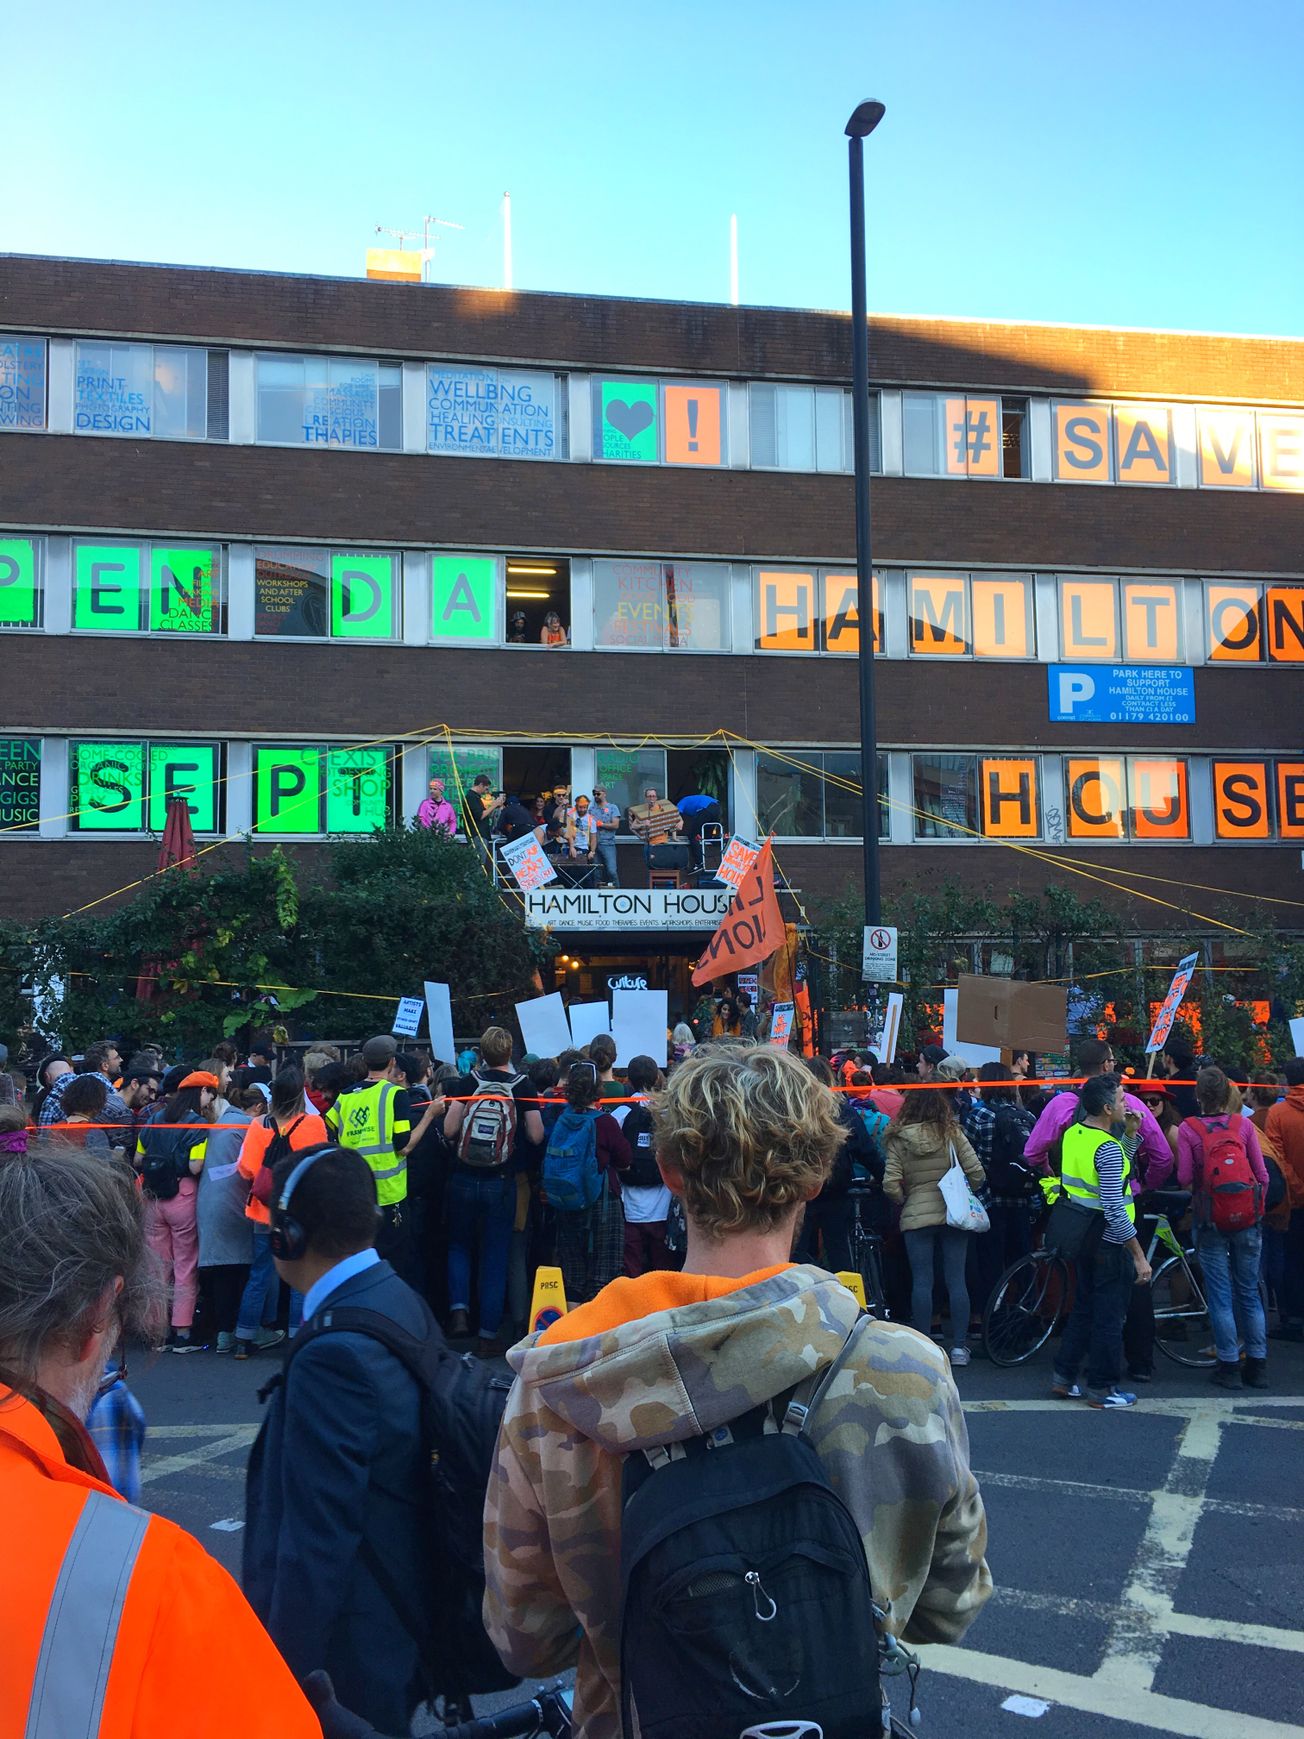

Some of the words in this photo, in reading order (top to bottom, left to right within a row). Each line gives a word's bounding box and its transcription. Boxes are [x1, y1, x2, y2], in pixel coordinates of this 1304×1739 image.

[77, 376, 126, 390] PRINT
[76, 413, 151, 431] DESIGN
[431, 411, 496, 427] HEALING
[257, 580, 308, 588] WORKSHOPS
[280, 588, 303, 596] AFTER
[261, 596, 295, 604] SCHOOL
[766, 584, 1304, 650] HAMILTON
[1112, 669, 1138, 678] PARK
[1141, 671, 1167, 679] HERE
[1169, 671, 1183, 679] TO
[1126, 679, 1171, 687] SUPPORT
[1059, 673, 1095, 713] P
[1109, 687, 1155, 695] HAMILTON
[1156, 688, 1189, 696] HOUSE
[1110, 712, 1144, 720] 01179
[1148, 713, 1189, 722] 420100
[5, 761, 38, 770] PARTY
[78, 771, 142, 786] DRINKS
[332, 779, 391, 797] SHOP
[0, 791, 38, 805] GIGS
[529, 895, 651, 914] HAMILTON
